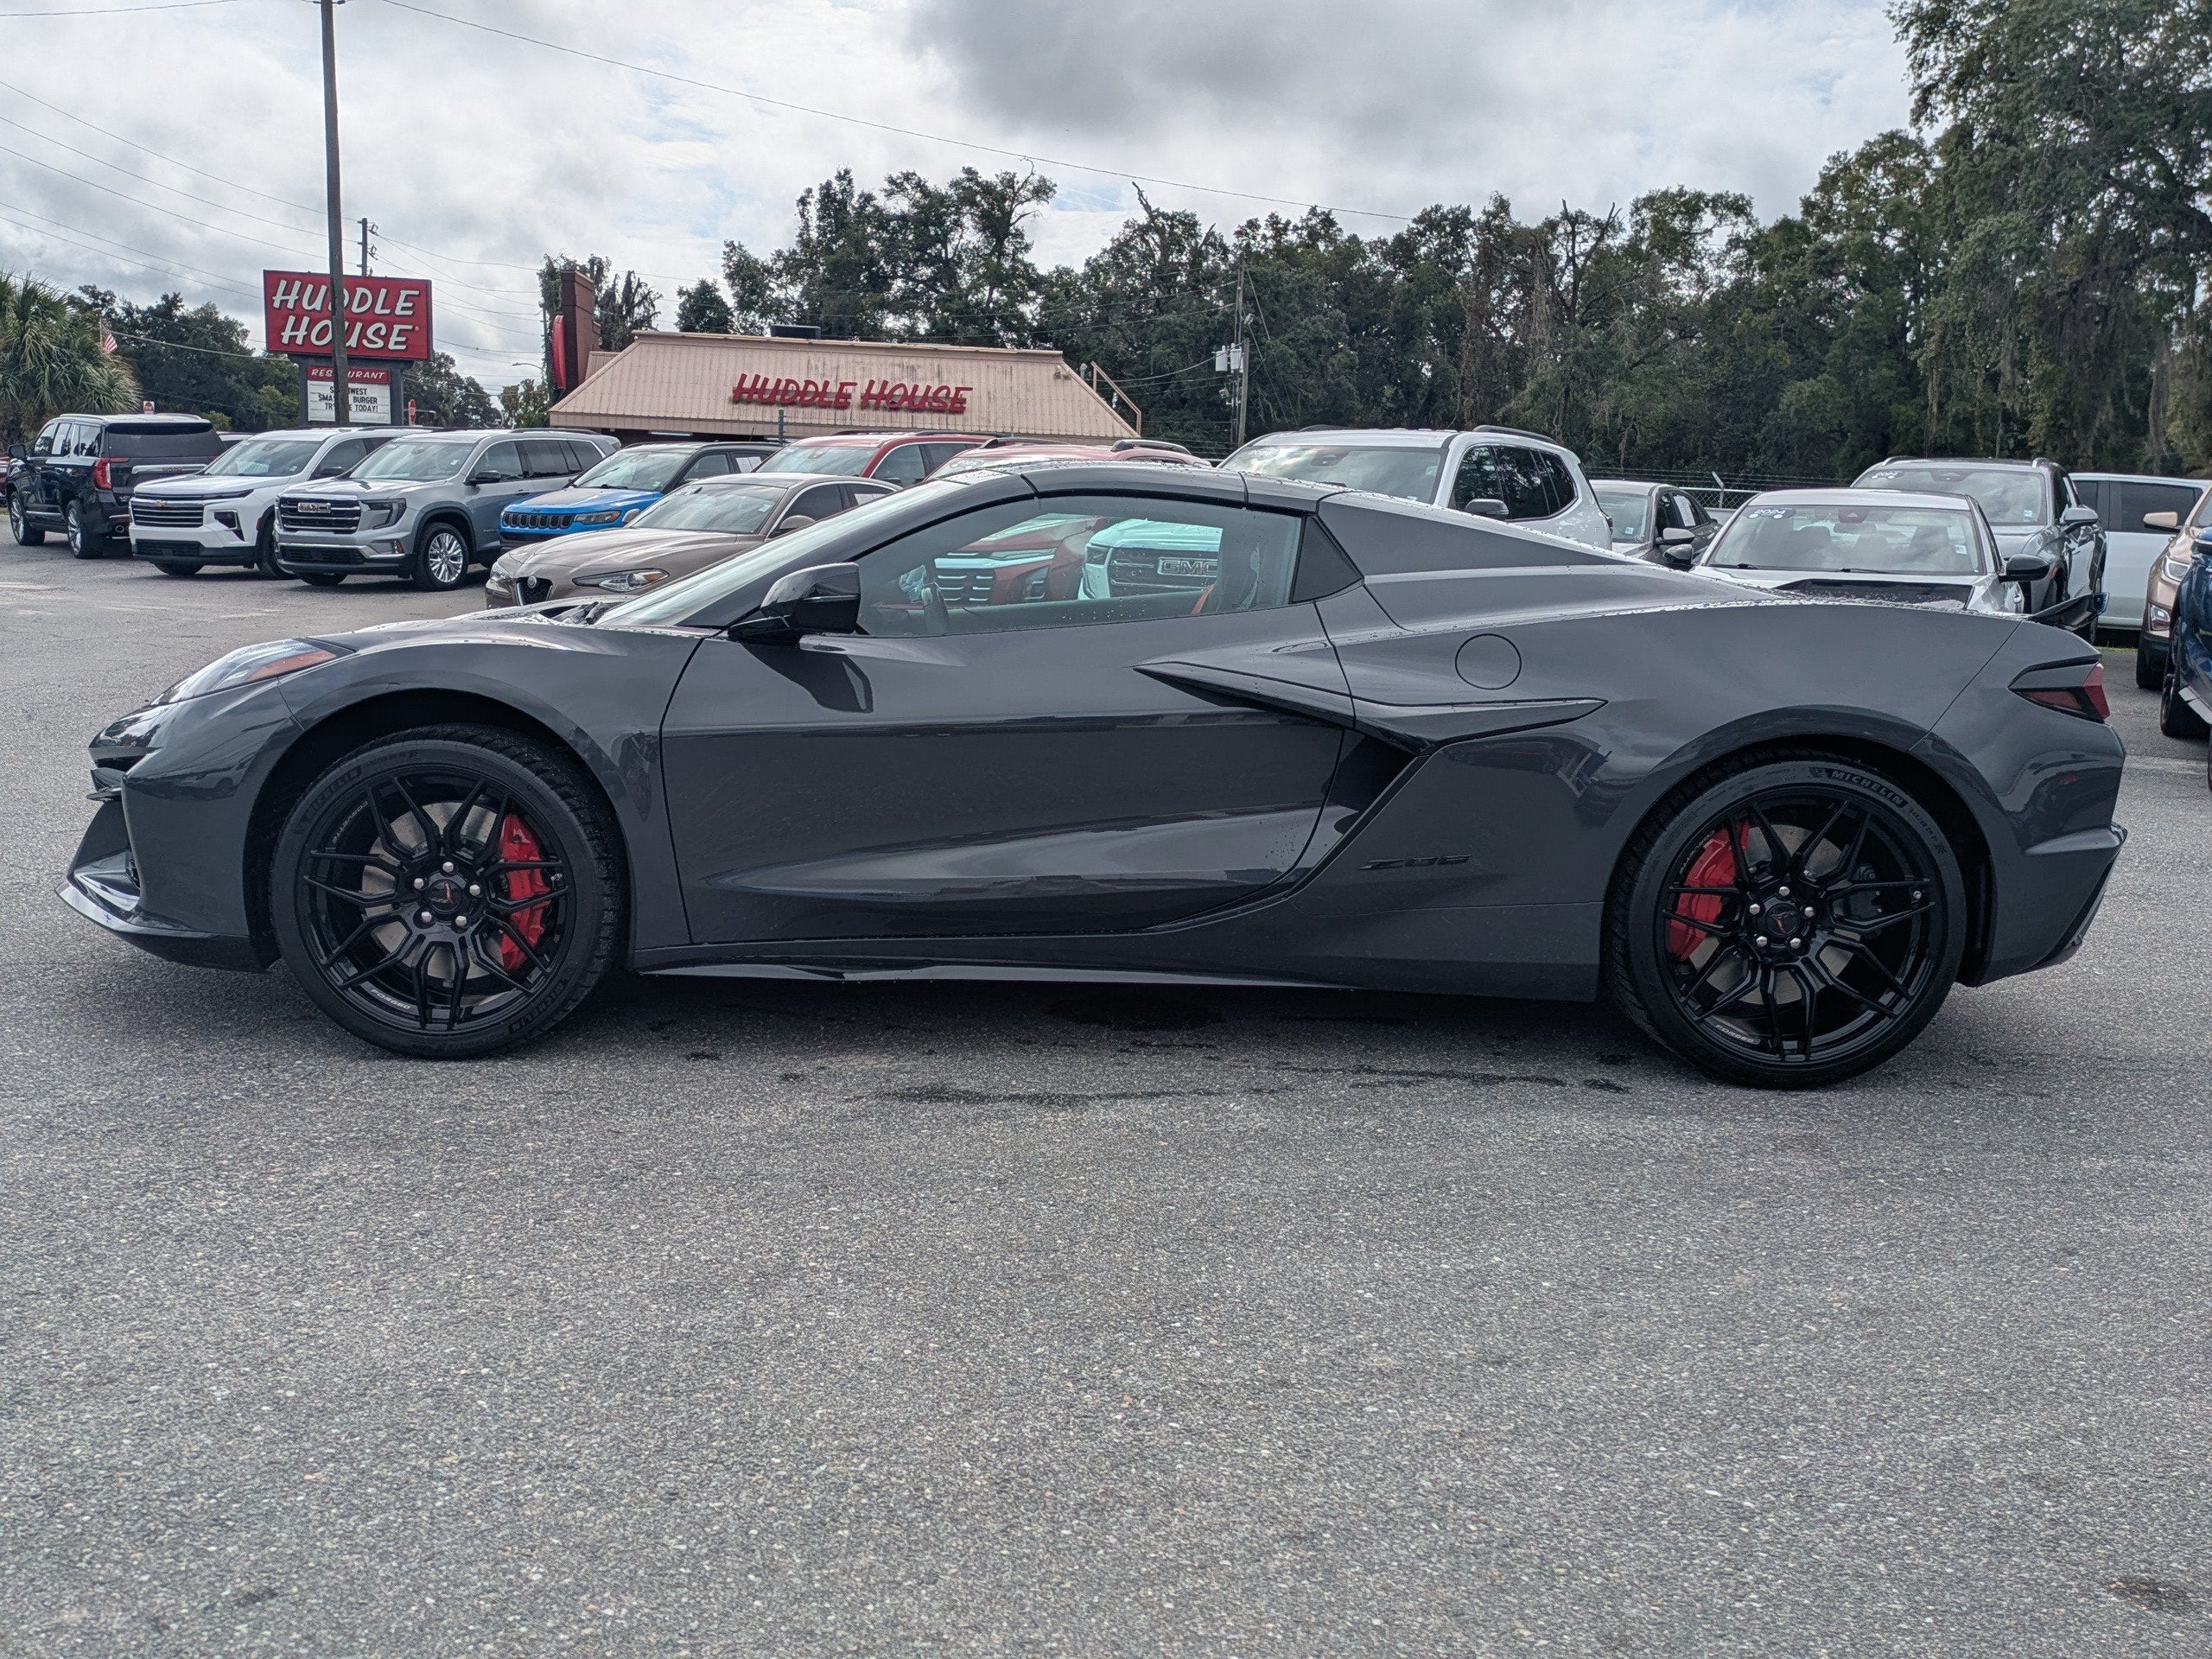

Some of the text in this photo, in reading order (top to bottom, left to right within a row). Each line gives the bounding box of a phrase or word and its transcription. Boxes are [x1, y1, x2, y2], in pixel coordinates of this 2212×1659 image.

[311, 369, 385, 379] RESURANT
[353, 396, 378, 404] BURGER
[733, 373, 974, 414] HUDDLE HOUSE
[1162, 559, 1218, 575] GMC
[1831, 770, 1905, 805] MICHELIN
[371, 988, 411, 1009] FORGED
[1715, 1024, 1754, 1043] FORGED
